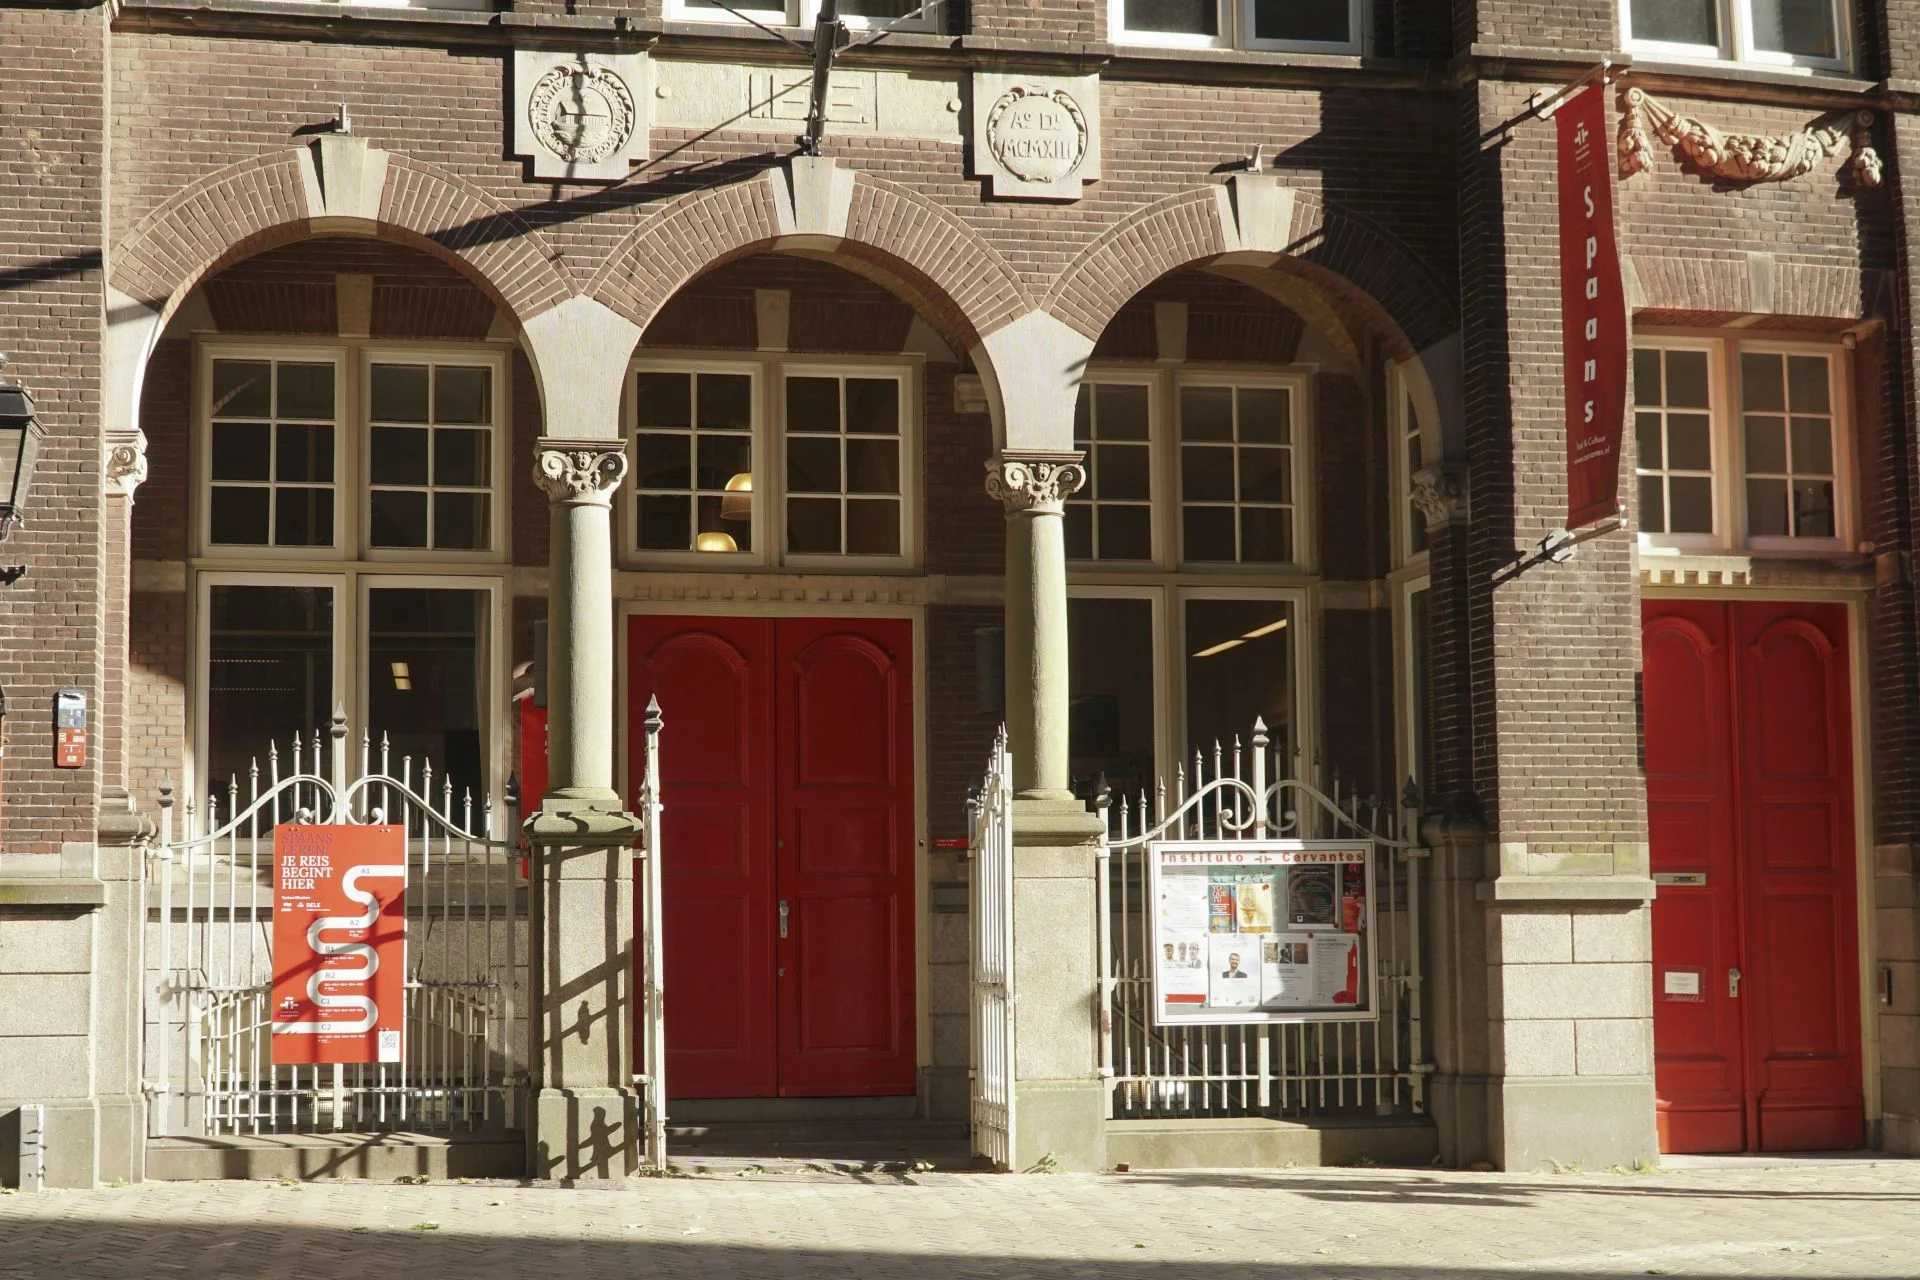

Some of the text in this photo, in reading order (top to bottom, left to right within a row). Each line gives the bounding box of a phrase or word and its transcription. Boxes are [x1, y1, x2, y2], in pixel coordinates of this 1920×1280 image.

[1001, 138, 1071, 160] MCMXIII
[1583, 185, 1598, 424] Spaans
[282, 832, 334, 844] SPAANS
[281, 855, 330, 867] JE REIS
[1161, 852, 1364, 863] Instituto Cervantes
[281, 867, 334, 878] BEGINT
[281, 878, 315, 890] HIER
